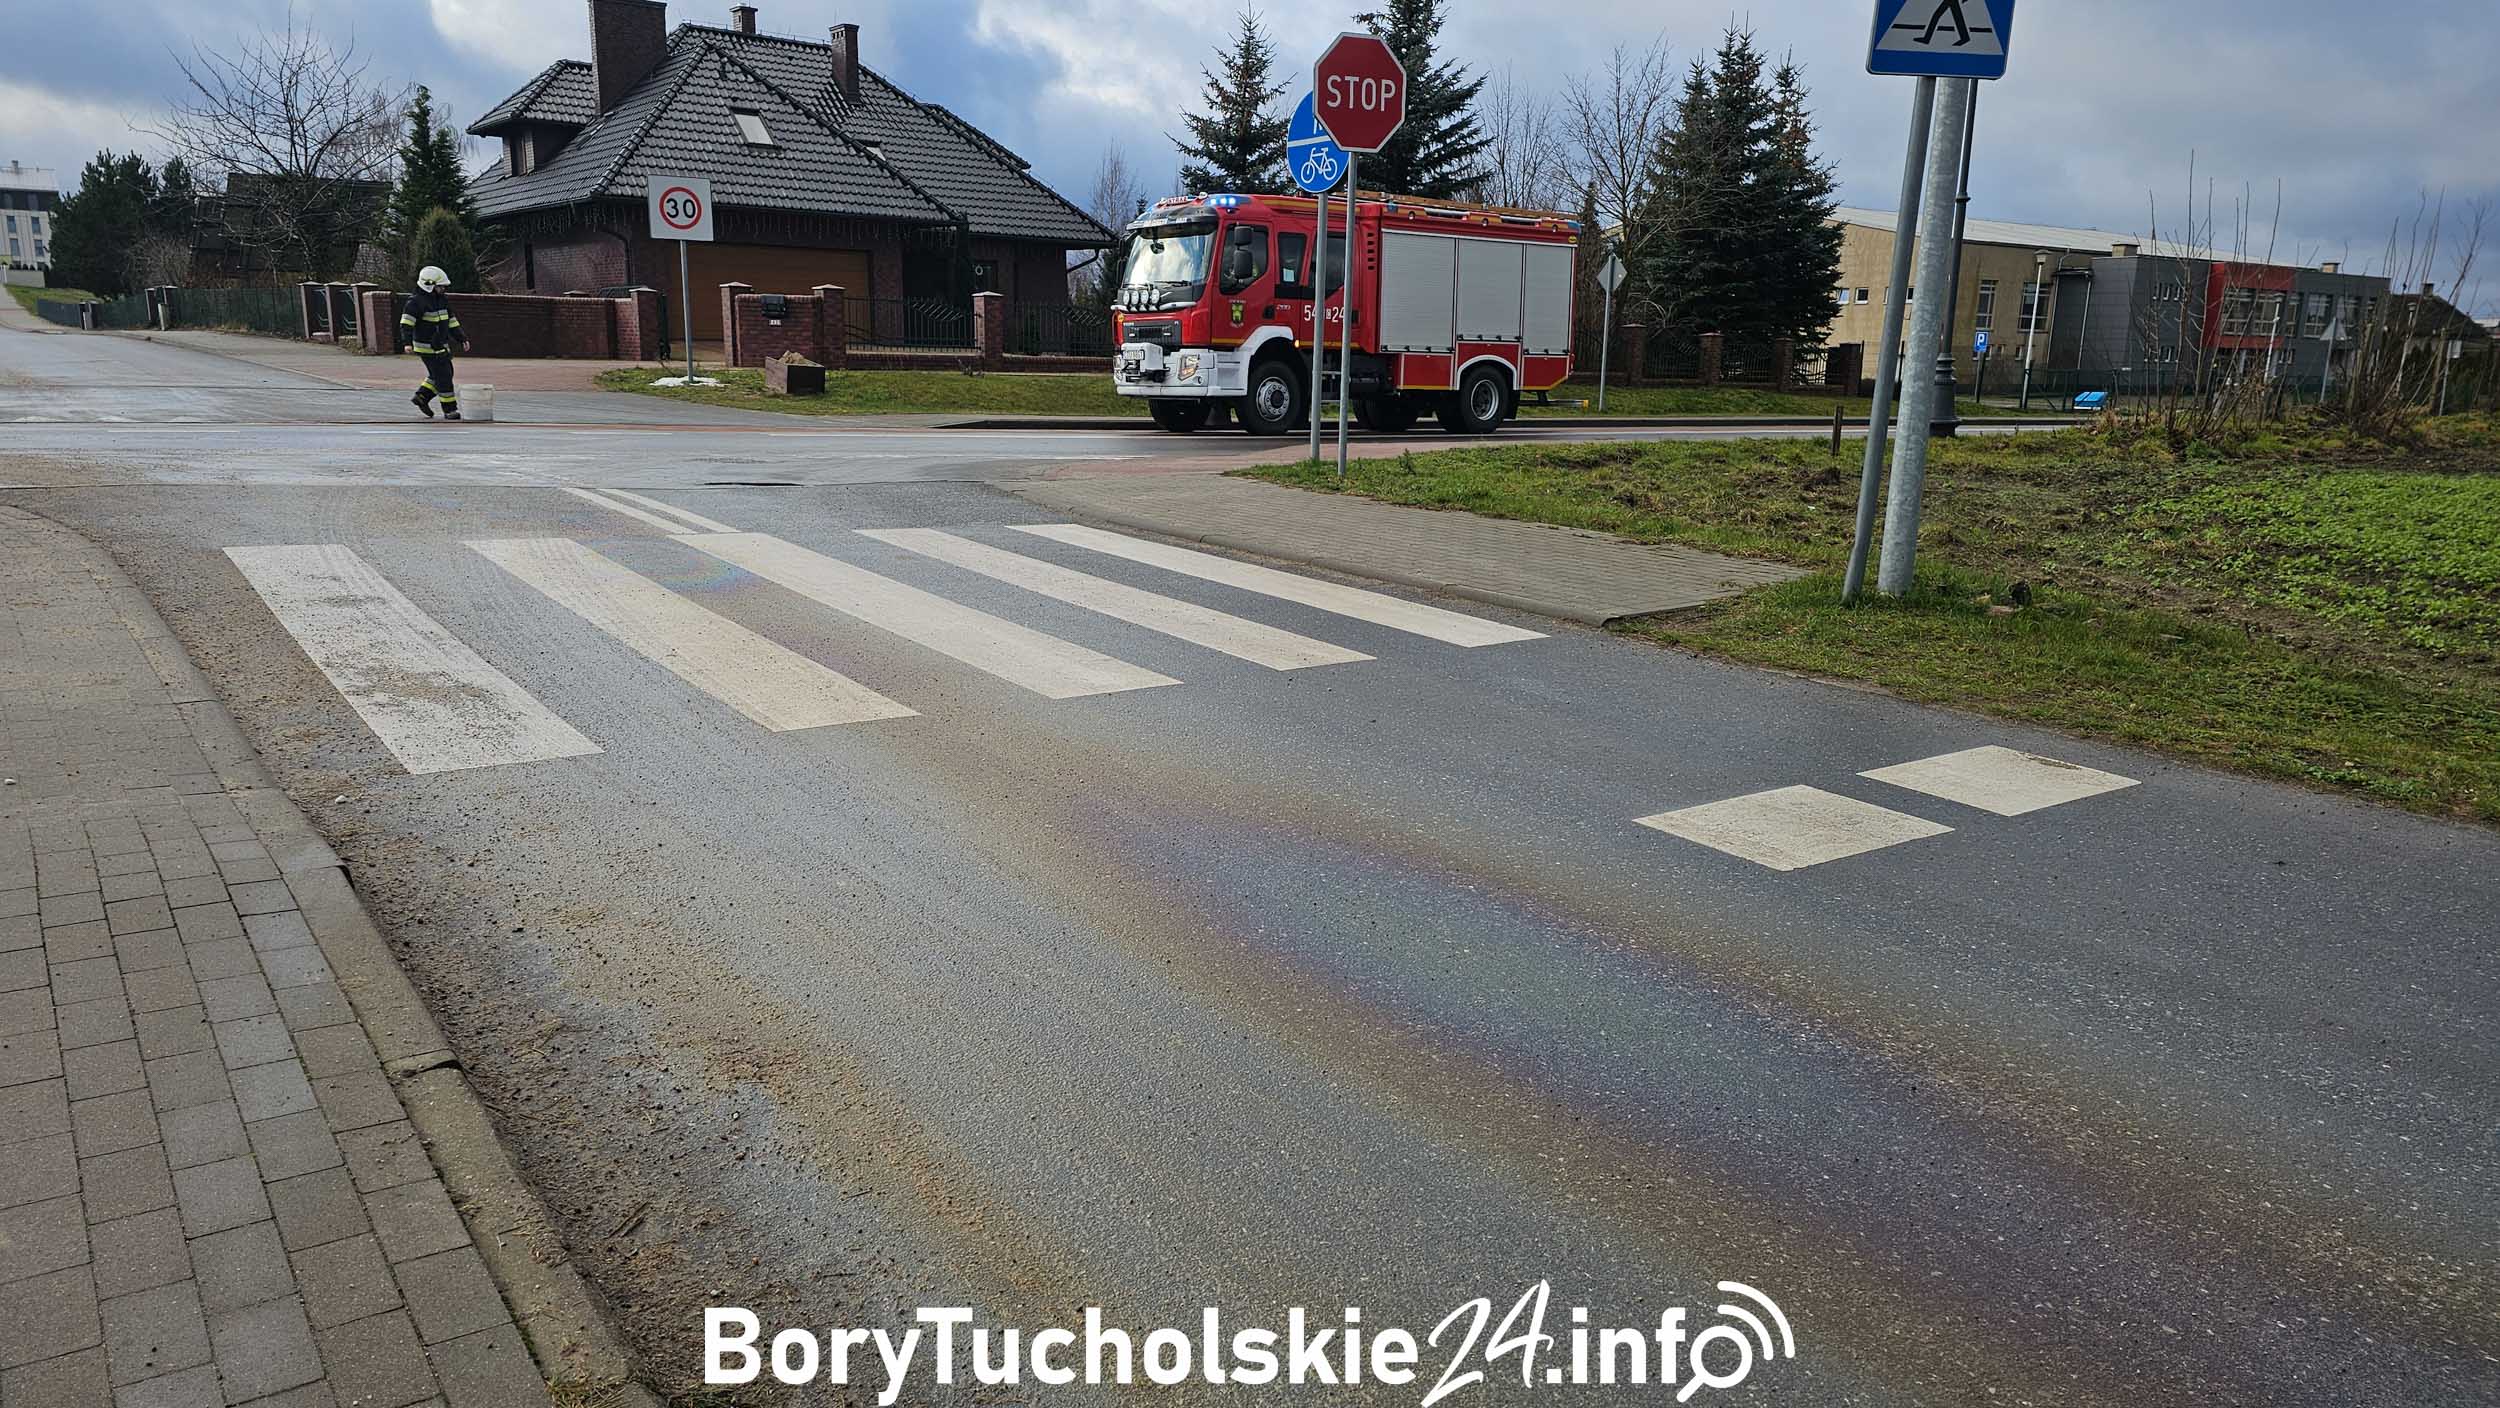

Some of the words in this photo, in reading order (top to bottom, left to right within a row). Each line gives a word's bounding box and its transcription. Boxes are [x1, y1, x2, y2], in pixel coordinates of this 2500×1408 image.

[1327, 75, 1396, 112] STOP
[666, 198, 697, 219] 30
[1977, 333, 1986, 347] P
